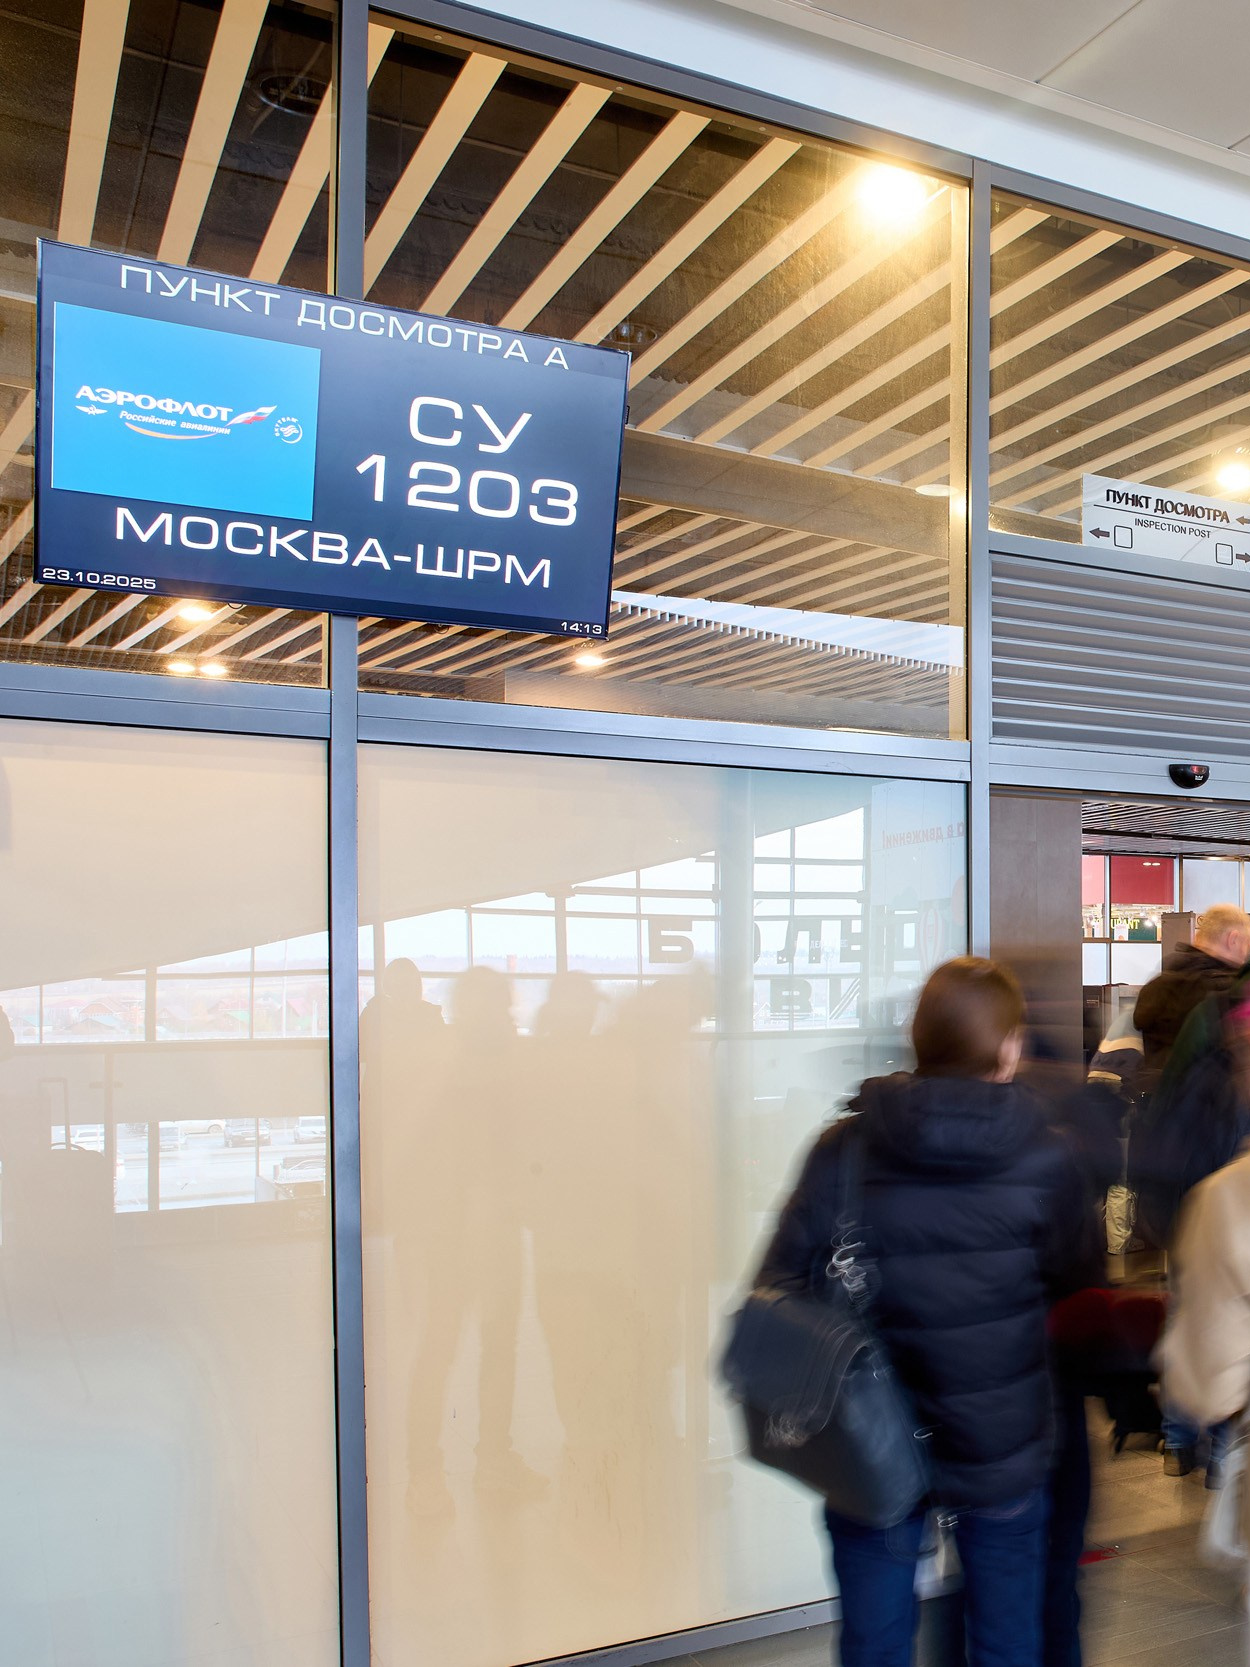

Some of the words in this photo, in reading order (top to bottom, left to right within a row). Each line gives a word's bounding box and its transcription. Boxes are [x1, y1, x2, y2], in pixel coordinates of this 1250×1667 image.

[121, 264, 281, 316] ПУНКТ
[297, 299, 530, 363] ДОСМОТРА
[543, 346, 570, 370] А
[75, 384, 233, 422] АЭРОФЛОТ
[119, 410, 177, 427] Российские
[180, 421, 231, 435] авиалинии
[409, 396, 532, 453] СУ
[356, 454, 579, 527] 1203
[1106, 488, 1152, 510] ПУНКТ
[1154, 498, 1231, 524] ДОСМОТРА
[1135, 518, 1187, 536] INSPECTION
[1188, 527, 1212, 539] POST
[115, 507, 551, 589] МОСКВА-ШРМ
[42, 567, 157, 590] 23.10.2025
[561, 621, 602, 635] 14:13
